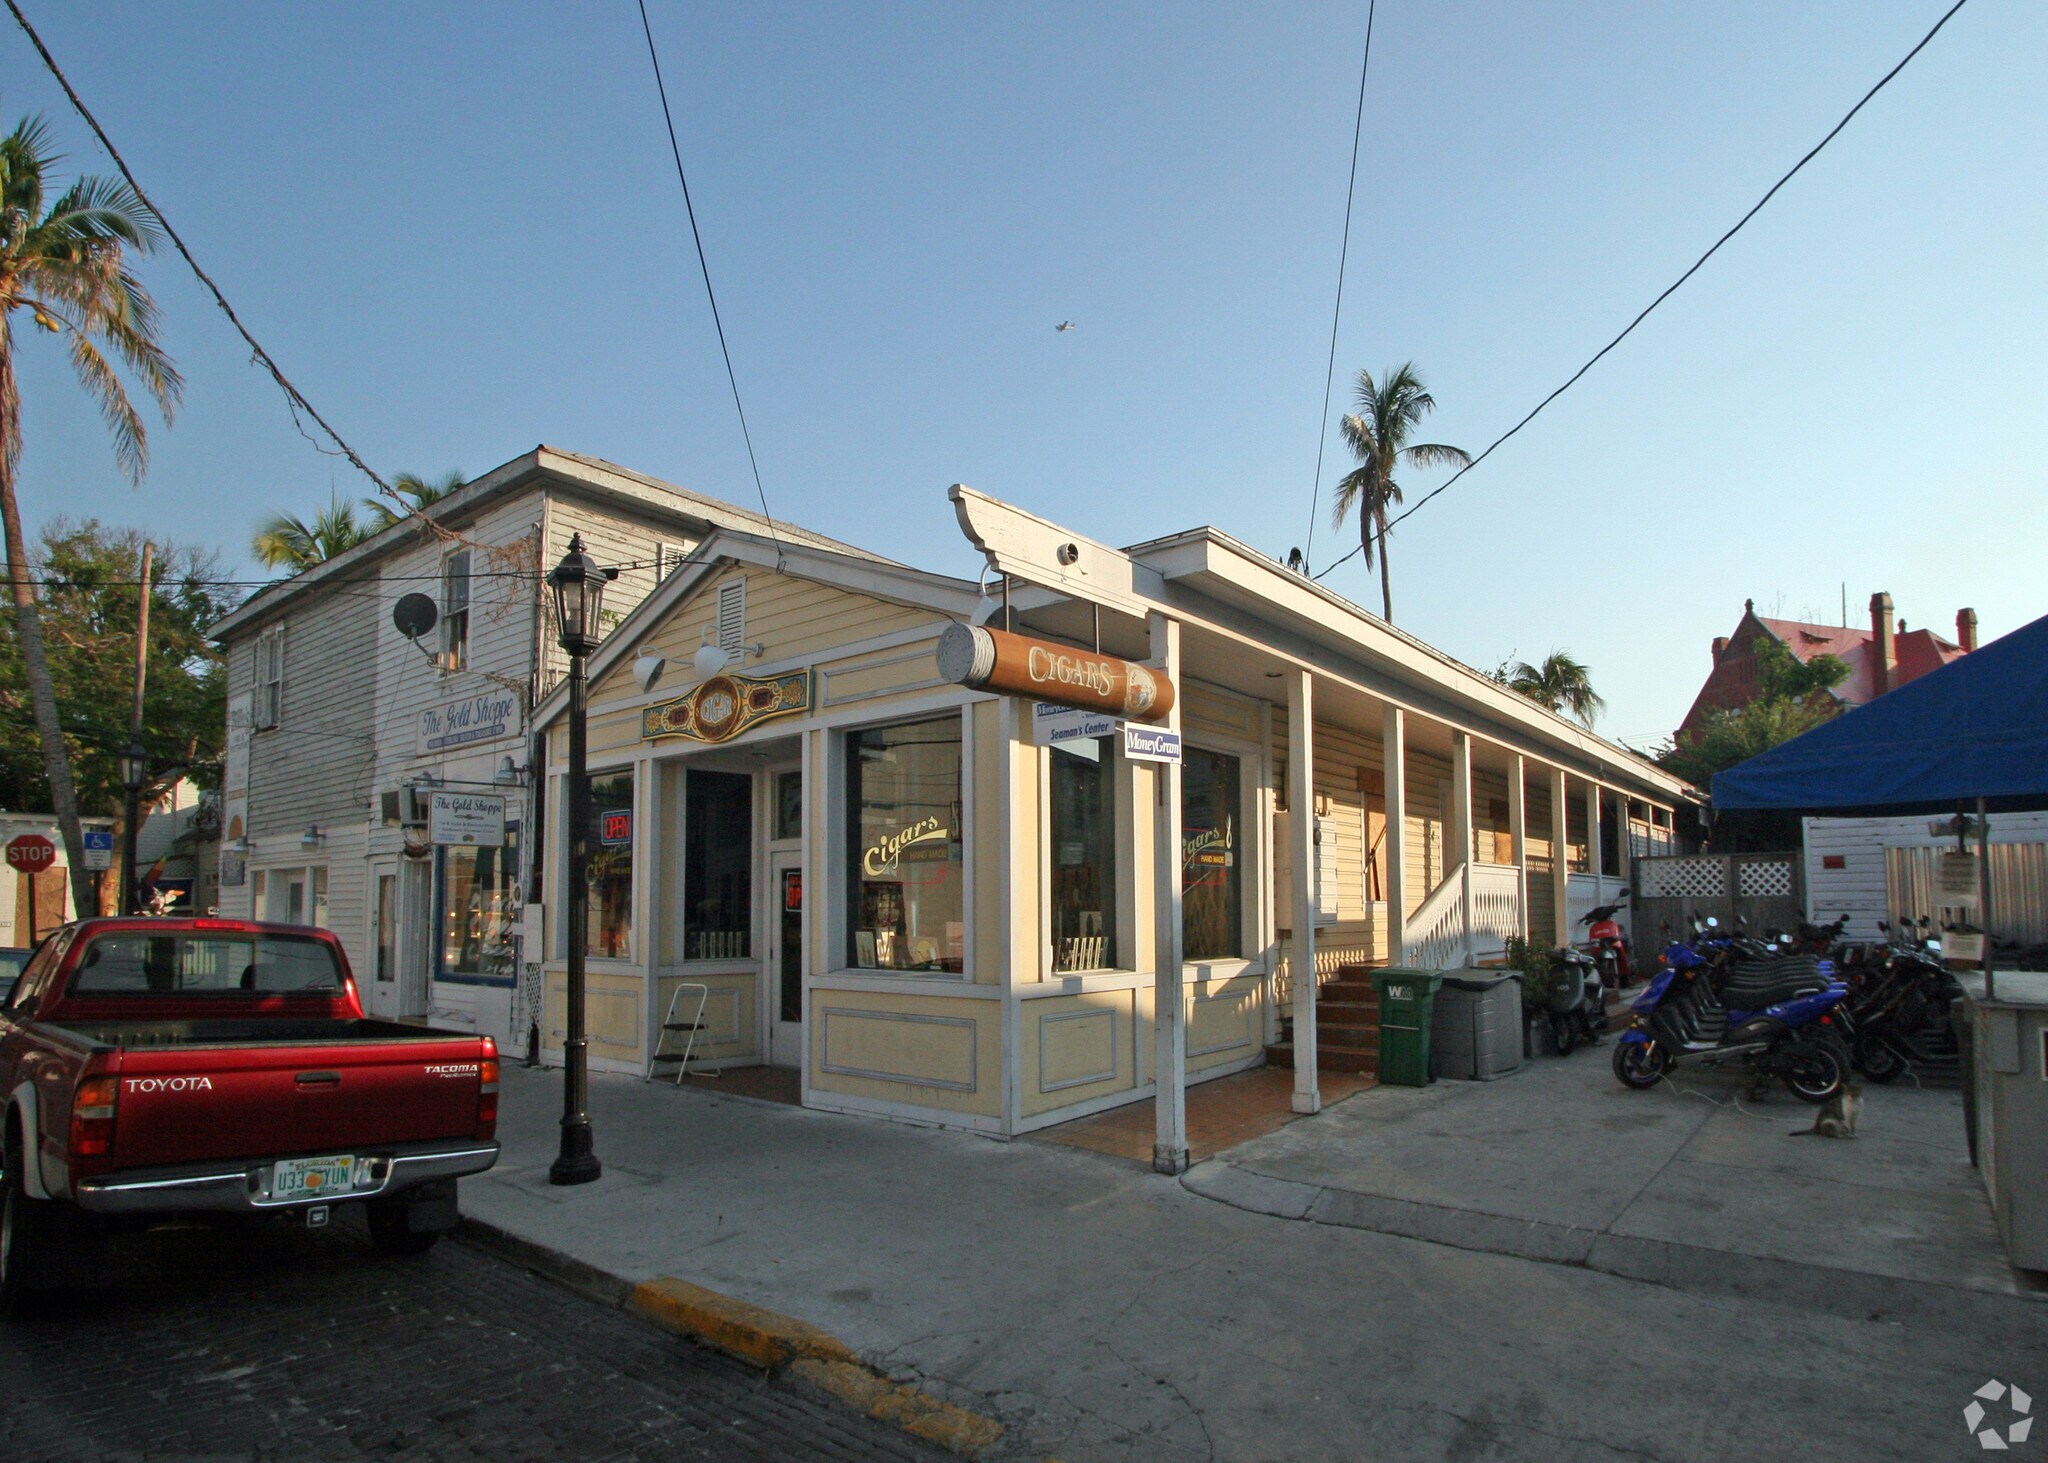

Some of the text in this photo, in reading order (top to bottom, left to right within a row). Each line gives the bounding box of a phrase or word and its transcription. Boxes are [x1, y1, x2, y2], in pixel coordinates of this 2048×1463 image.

[1028, 646, 1115, 696] CIGARS
[422, 711, 442, 736] The
[446, 700, 472, 735] Gold
[473, 697, 514, 726] Shoppe
[701, 693, 733, 723] CIGAR
[1050, 722, 1109, 741] Seaman's Center
[1126, 732, 1180, 755] MoneyGram
[434, 797, 502, 815] The Gold Shoppe
[604, 816, 630, 839] OPEN
[9, 846, 53, 861] STOP
[863, 815, 948, 877] Cigars
[1182, 827, 1225, 869] igars
[1201, 854, 1225, 864] HAND MADE
[424, 1064, 478, 1073] TACOMA
[125, 1077, 213, 1093] TOYOTA
[278, 1167, 349, 1191] U33 YUN
